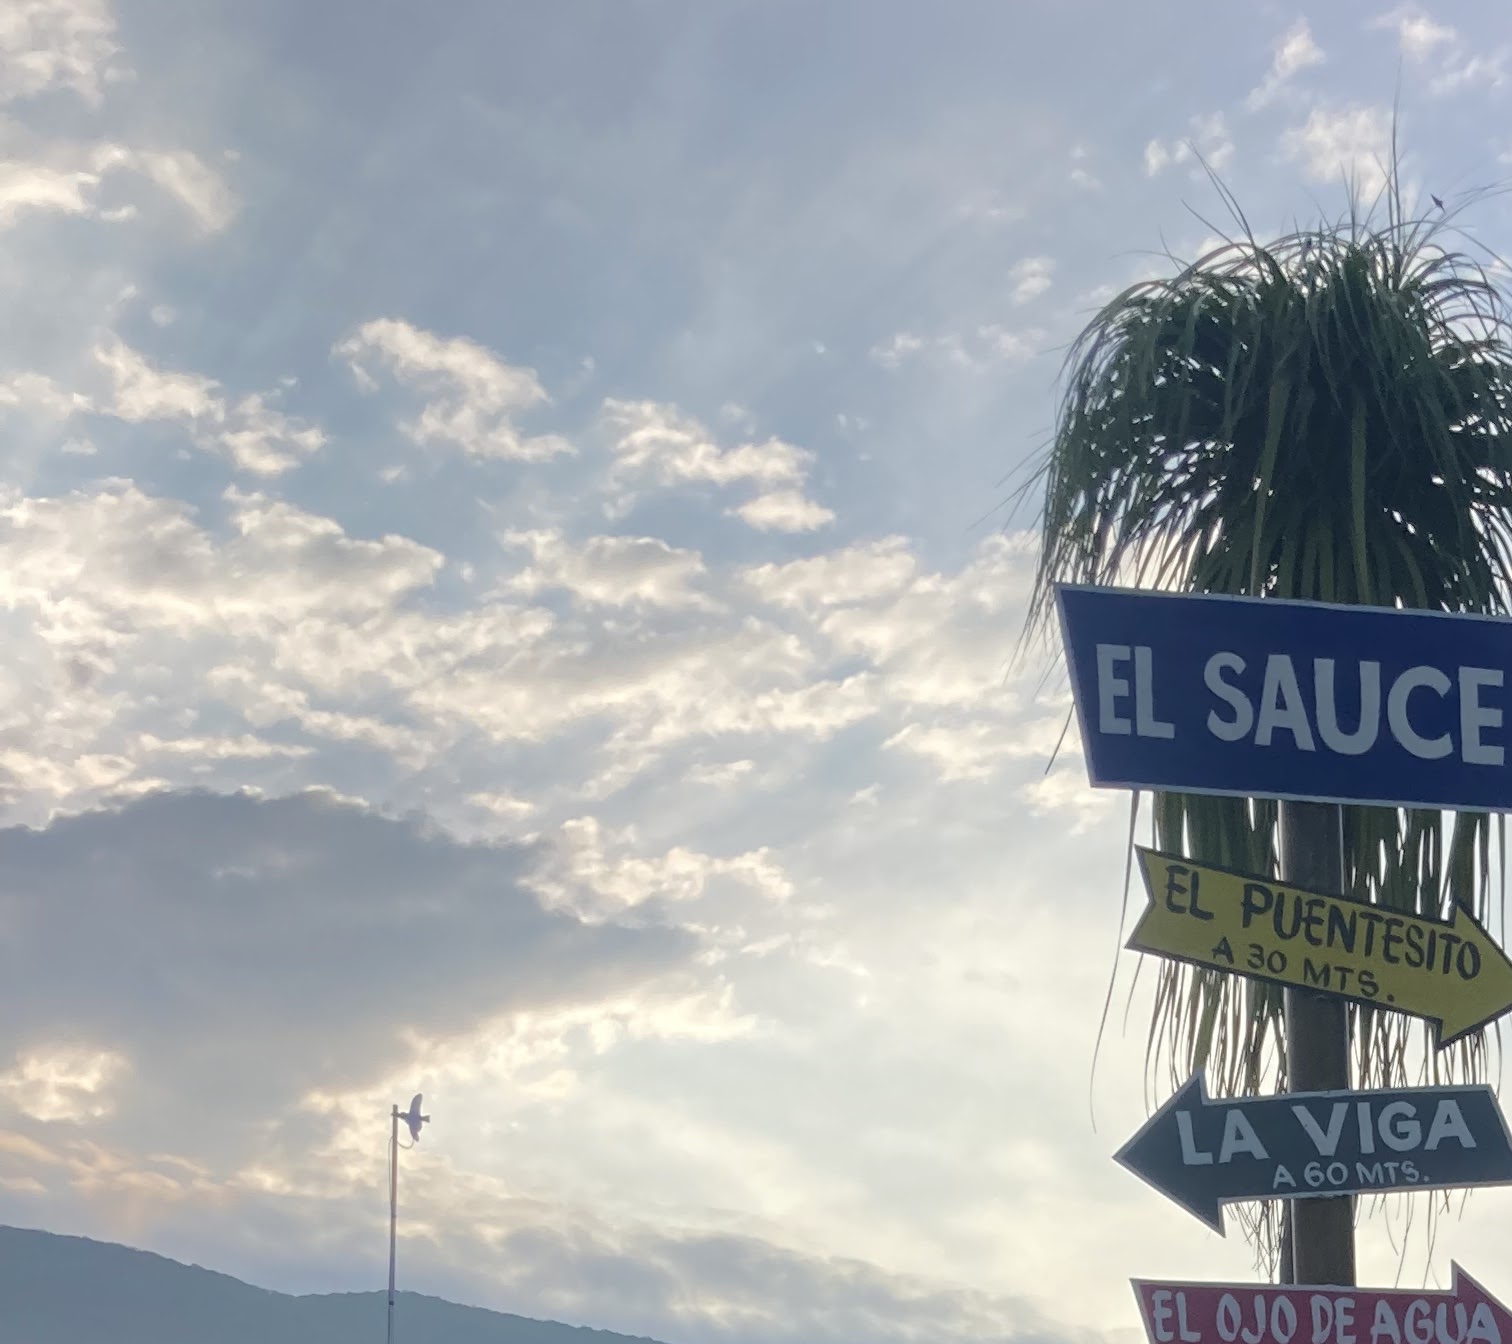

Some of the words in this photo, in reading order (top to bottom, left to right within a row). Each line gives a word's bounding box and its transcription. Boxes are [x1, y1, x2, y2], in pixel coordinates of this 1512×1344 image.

[1095, 643, 1176, 738] EL
[1203, 651, 1505, 766] SAUCE
[1164, 865, 1214, 920] EL
[1242, 883, 1481, 980] PUENTESITO
[1212, 937, 1234, 964] A
[1247, 945, 1287, 974] 30
[1303, 960, 1396, 1003] MTS.
[1175, 1109, 1270, 1165] LA
[1291, 1100, 1477, 1156] VIGA
[1273, 1165, 1296, 1189] A
[1304, 1164, 1348, 1187] 60
[1356, 1161, 1431, 1184] MTS.
[1152, 1290, 1201, 1343] EL
